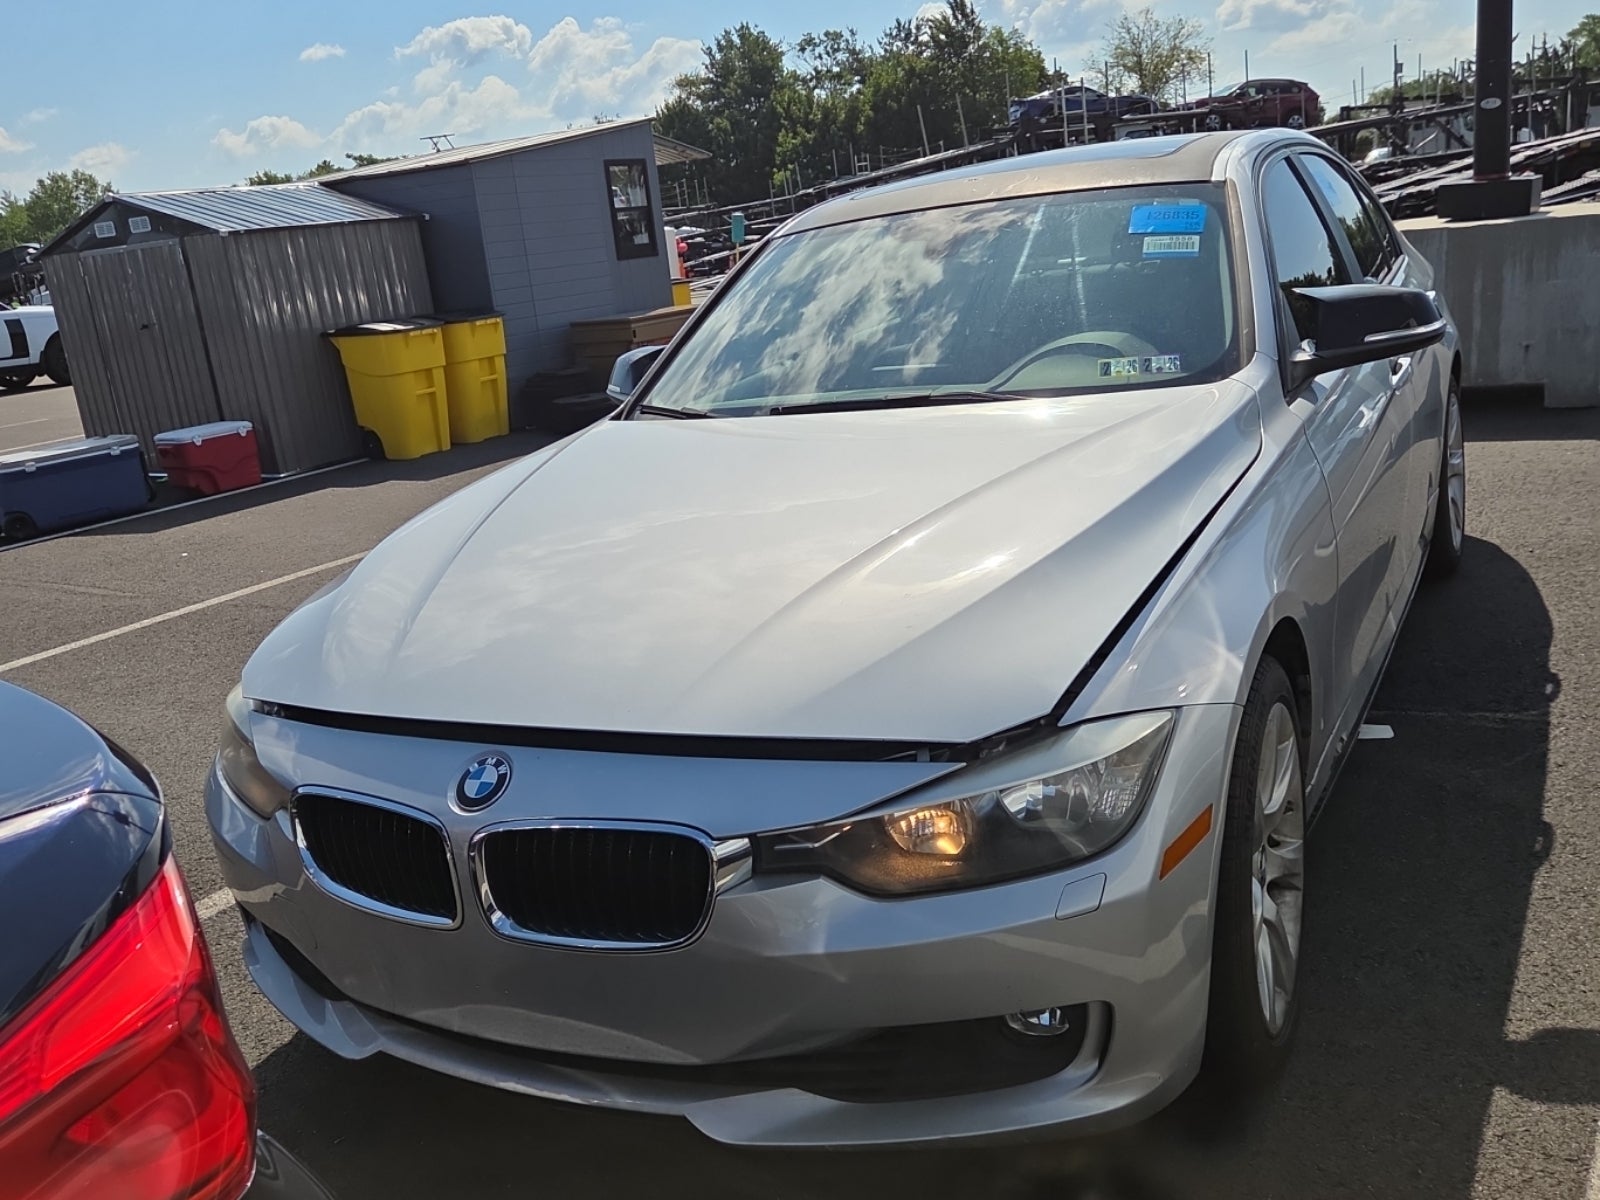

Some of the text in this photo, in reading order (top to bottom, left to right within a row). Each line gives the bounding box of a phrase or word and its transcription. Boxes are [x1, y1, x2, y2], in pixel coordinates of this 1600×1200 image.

[1147, 210, 1200, 220] 126835
[1144, 356, 1179, 372] 2 26
[469, 757, 508, 774] BMW
